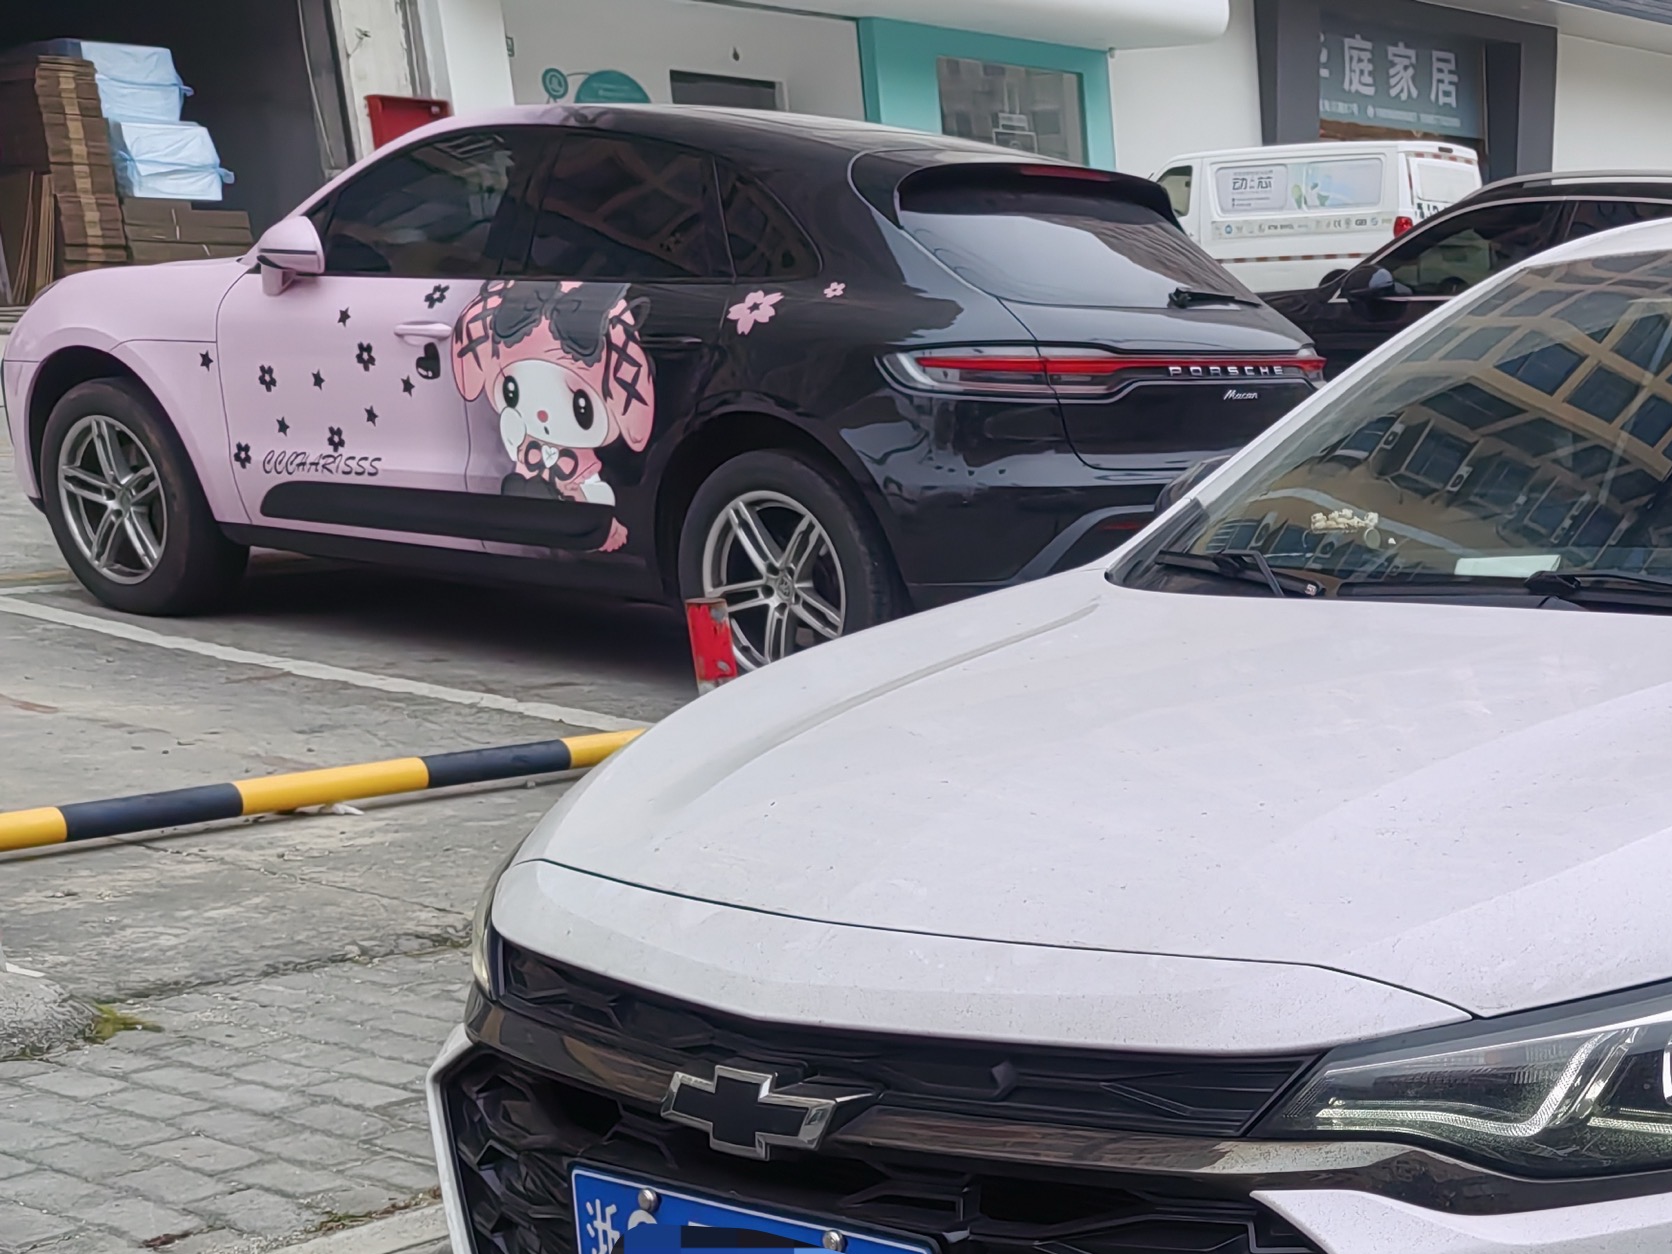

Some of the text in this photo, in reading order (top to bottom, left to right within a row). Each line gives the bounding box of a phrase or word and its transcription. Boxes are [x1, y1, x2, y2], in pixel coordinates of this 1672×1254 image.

[1320, 32, 1459, 108] 庭家居
[1168, 366, 1285, 377] PORSCHE
[1223, 389, 1259, 400] Macan
